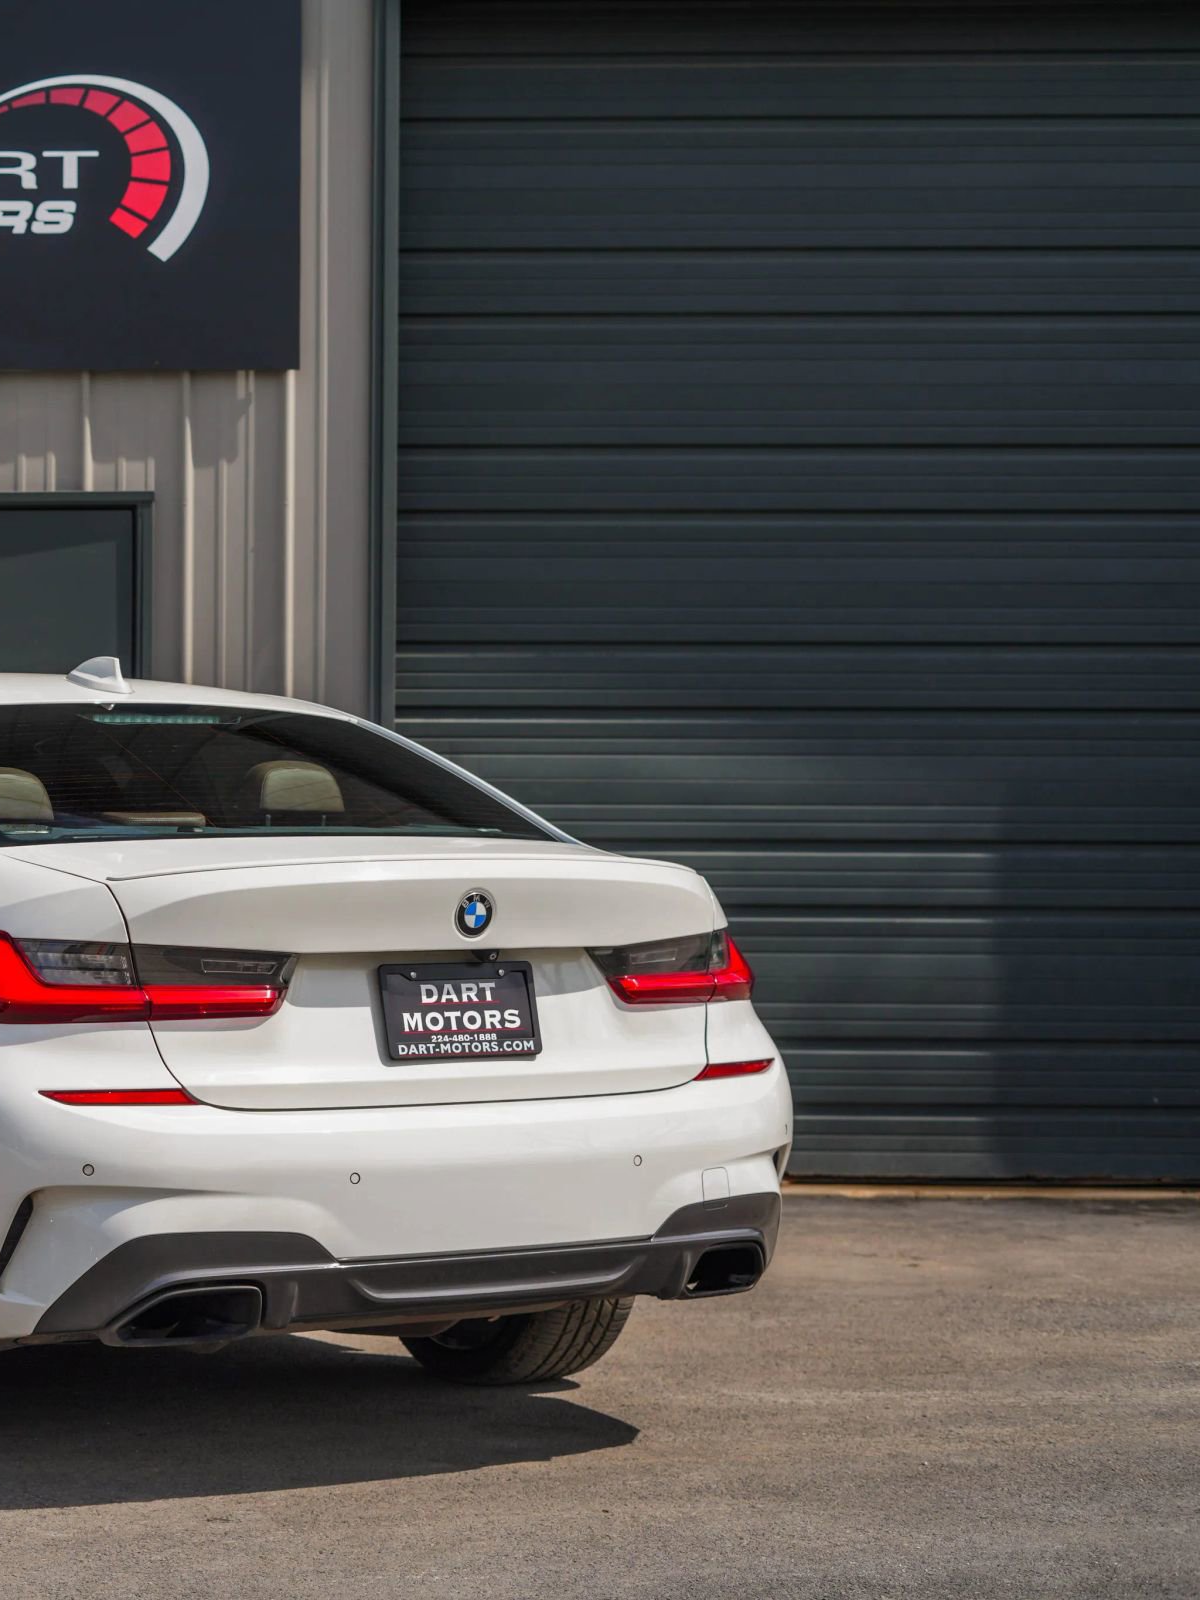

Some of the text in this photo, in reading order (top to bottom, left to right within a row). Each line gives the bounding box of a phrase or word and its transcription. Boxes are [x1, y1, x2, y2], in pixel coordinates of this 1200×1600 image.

[461, 893, 491, 909] BMW
[420, 982, 496, 1004] DART
[402, 1009, 521, 1032] MOTORS
[431, 1033, 497, 1042] 224-480-1888
[398, 1040, 534, 1055] DART-MOTORS.COM
